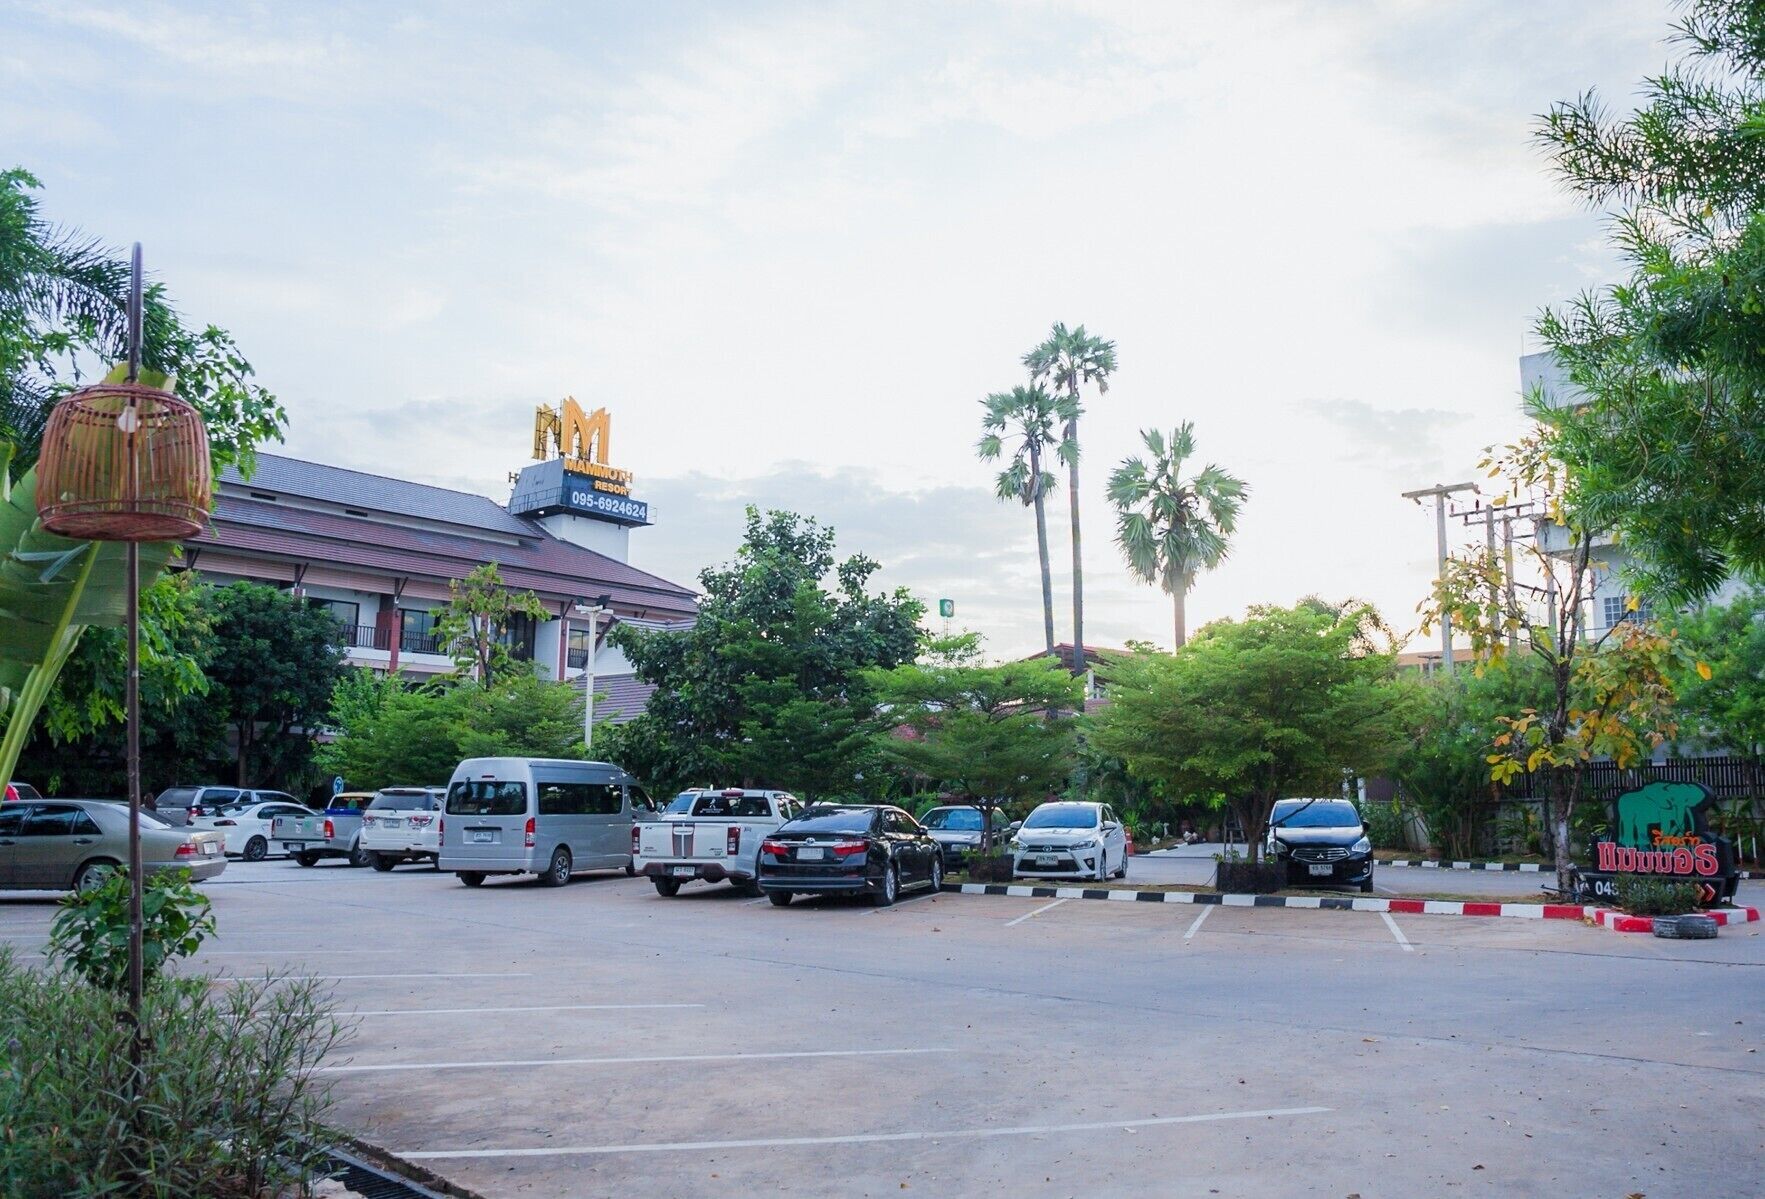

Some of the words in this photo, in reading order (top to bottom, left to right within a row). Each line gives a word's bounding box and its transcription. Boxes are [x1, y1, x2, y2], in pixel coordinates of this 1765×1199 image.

[564, 457, 633, 483] MAMMOTH
[594, 479, 632, 496] RESORT
[572, 491, 646, 518] 095-6924624
